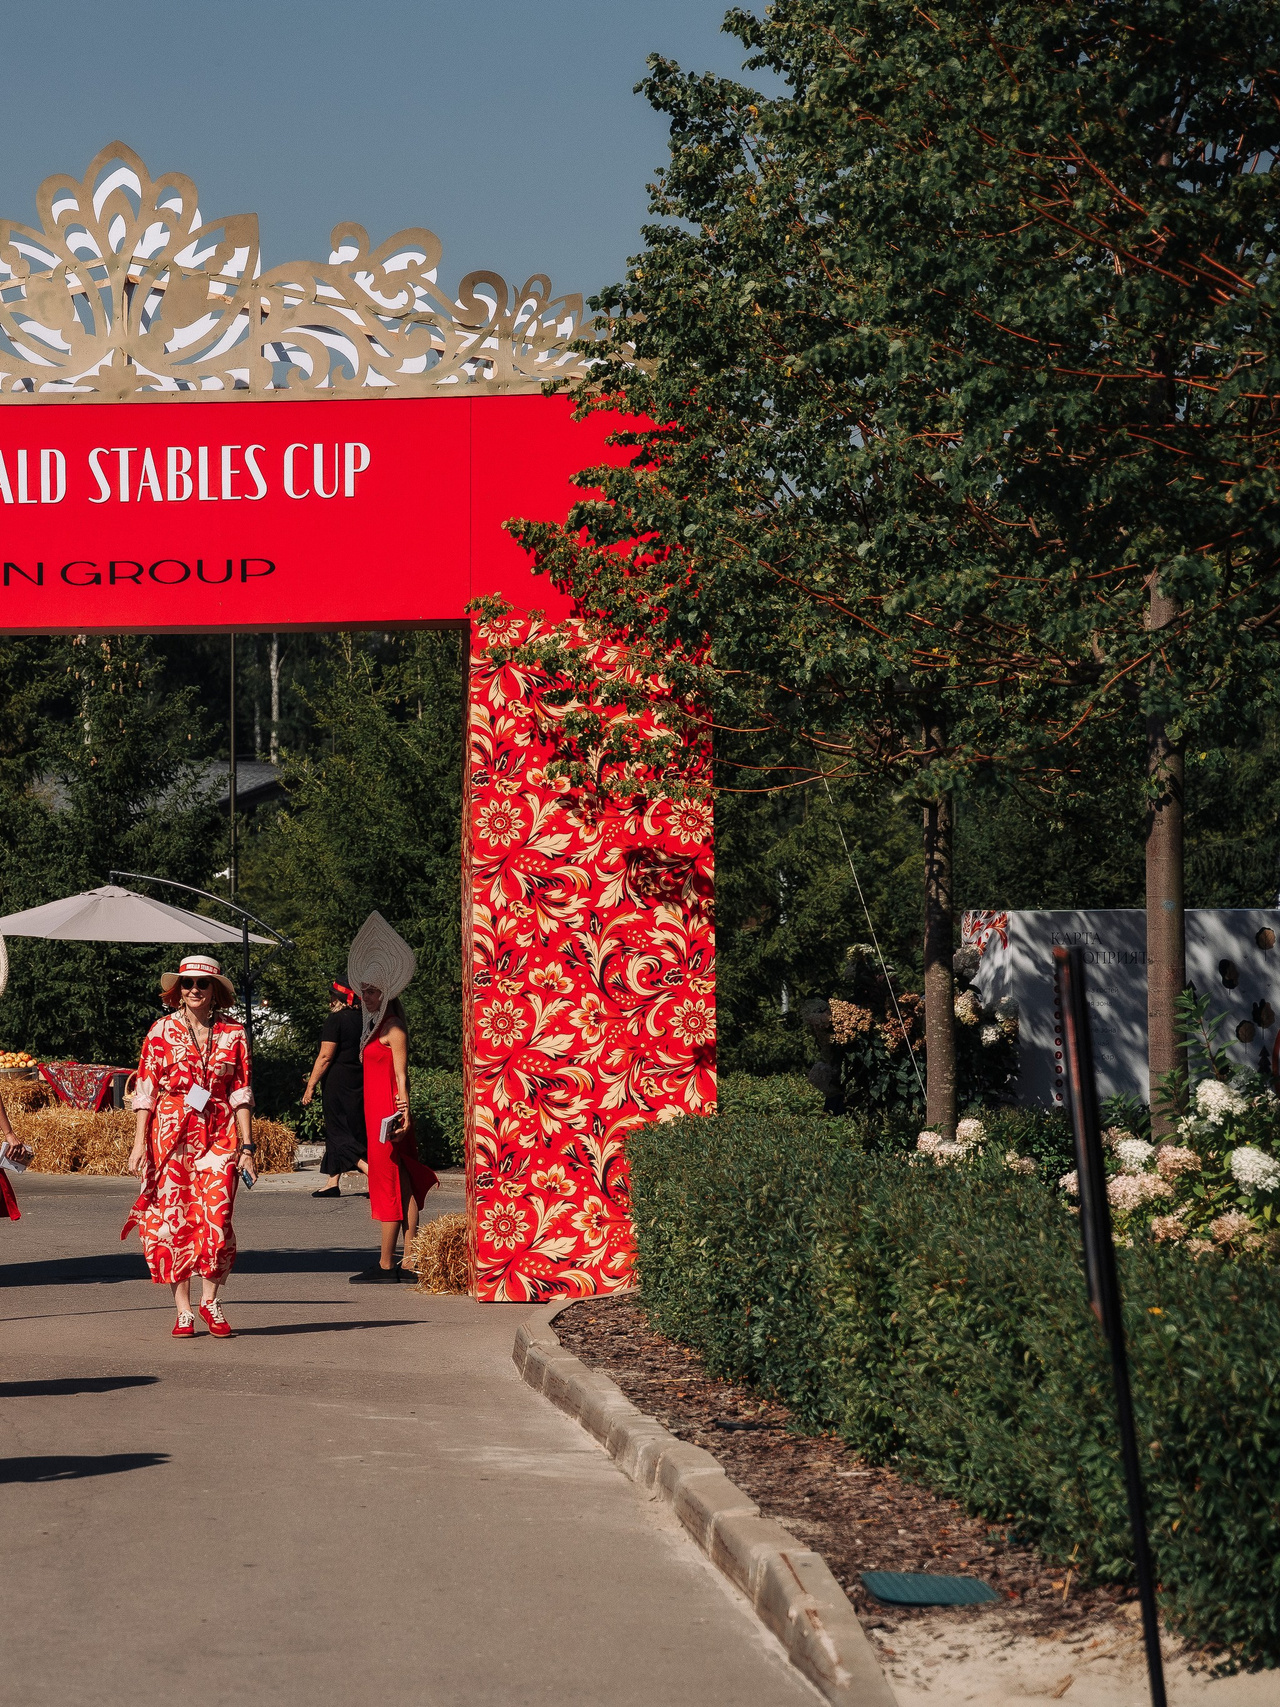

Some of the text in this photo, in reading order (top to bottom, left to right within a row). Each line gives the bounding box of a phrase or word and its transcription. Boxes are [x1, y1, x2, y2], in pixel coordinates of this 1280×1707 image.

[88, 443, 267, 504] STABLES
[283, 441, 371, 499] CUP
[60, 557, 277, 587] GROUP
[1051, 931, 1103, 945] КАРТА
